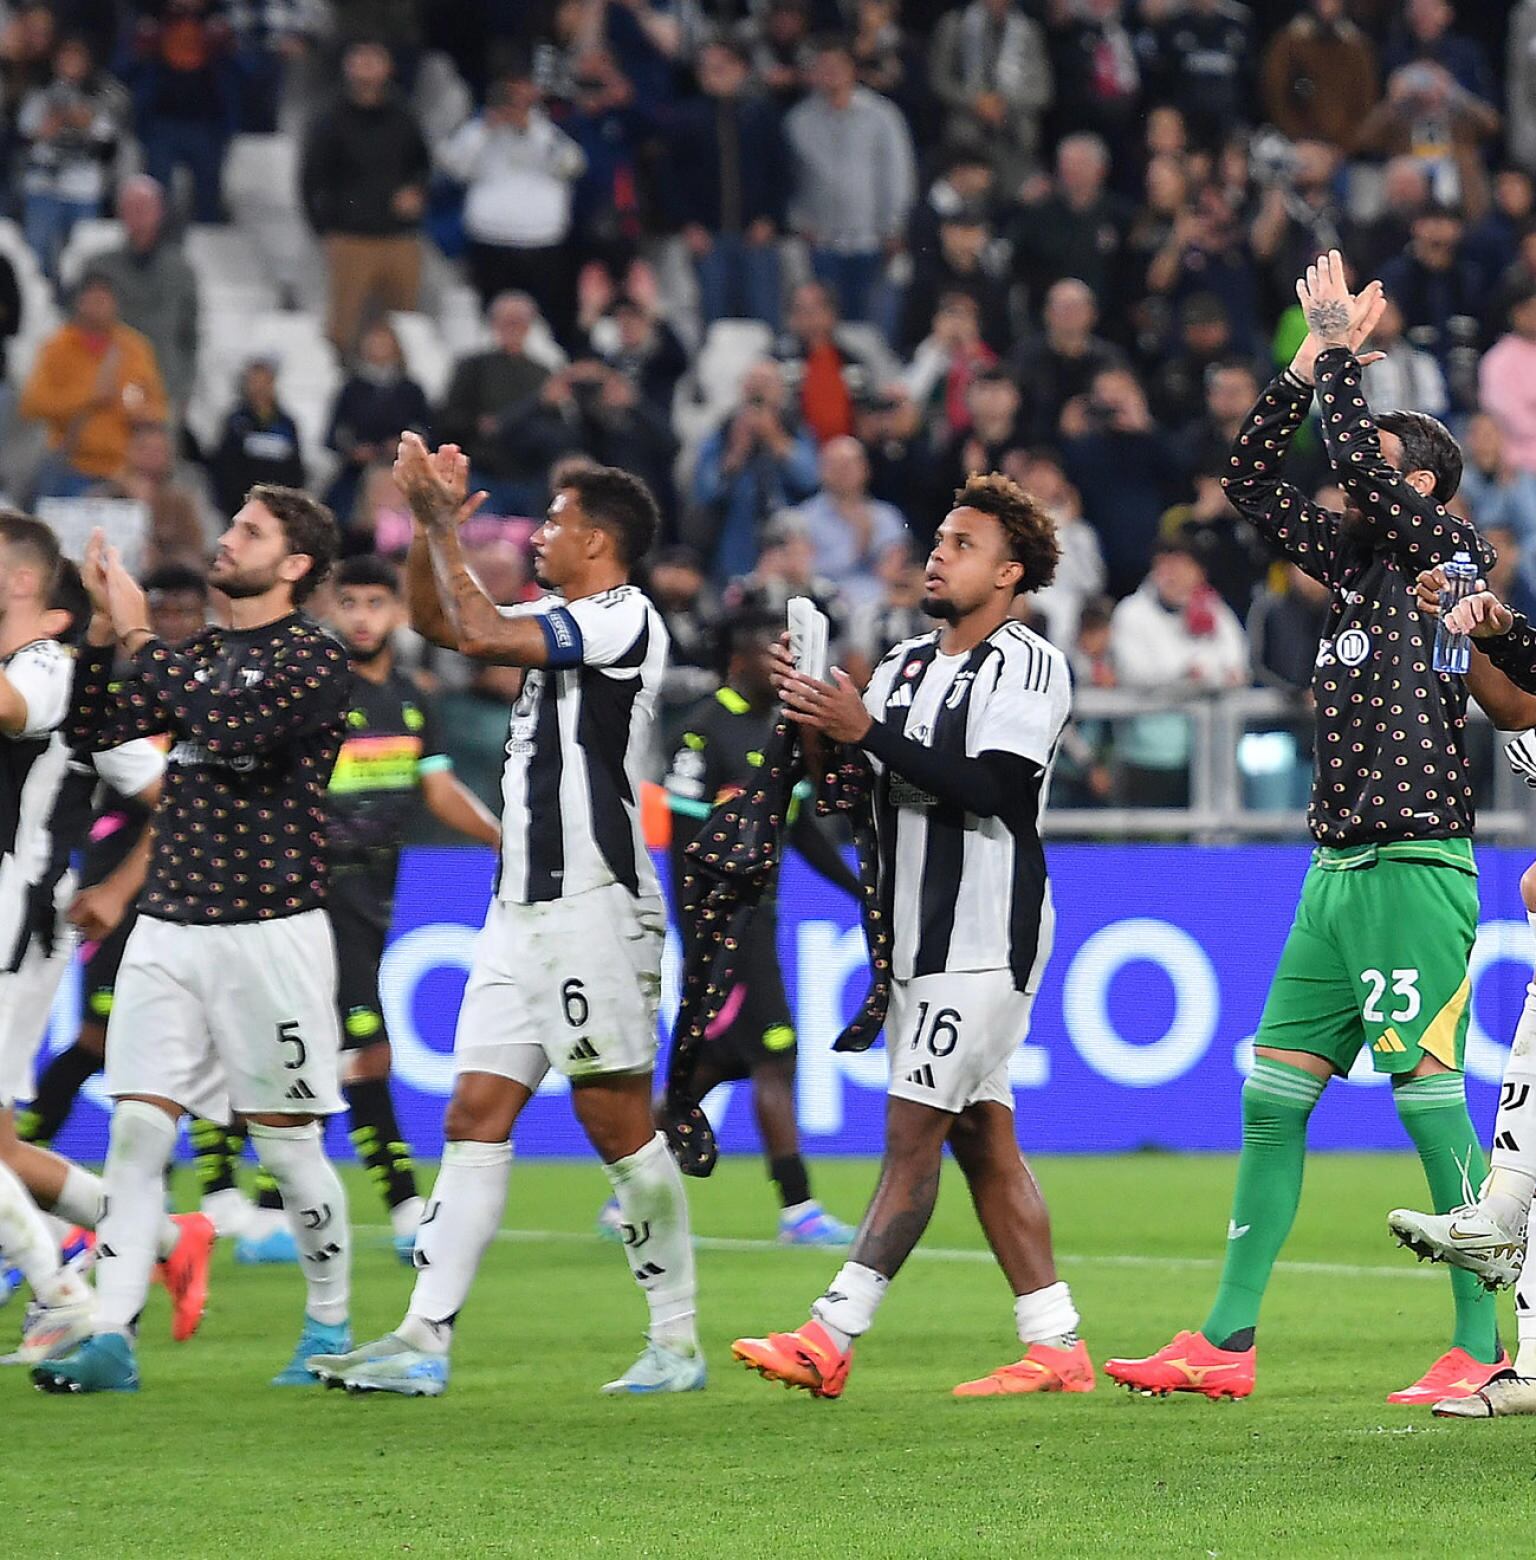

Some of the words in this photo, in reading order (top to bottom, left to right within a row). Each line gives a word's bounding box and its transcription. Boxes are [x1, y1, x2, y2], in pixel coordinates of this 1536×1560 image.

[563, 977, 589, 1027] 6
[1361, 969, 1421, 1023] 23
[275, 1021, 306, 1069] 5
[911, 1001, 962, 1056] 16
